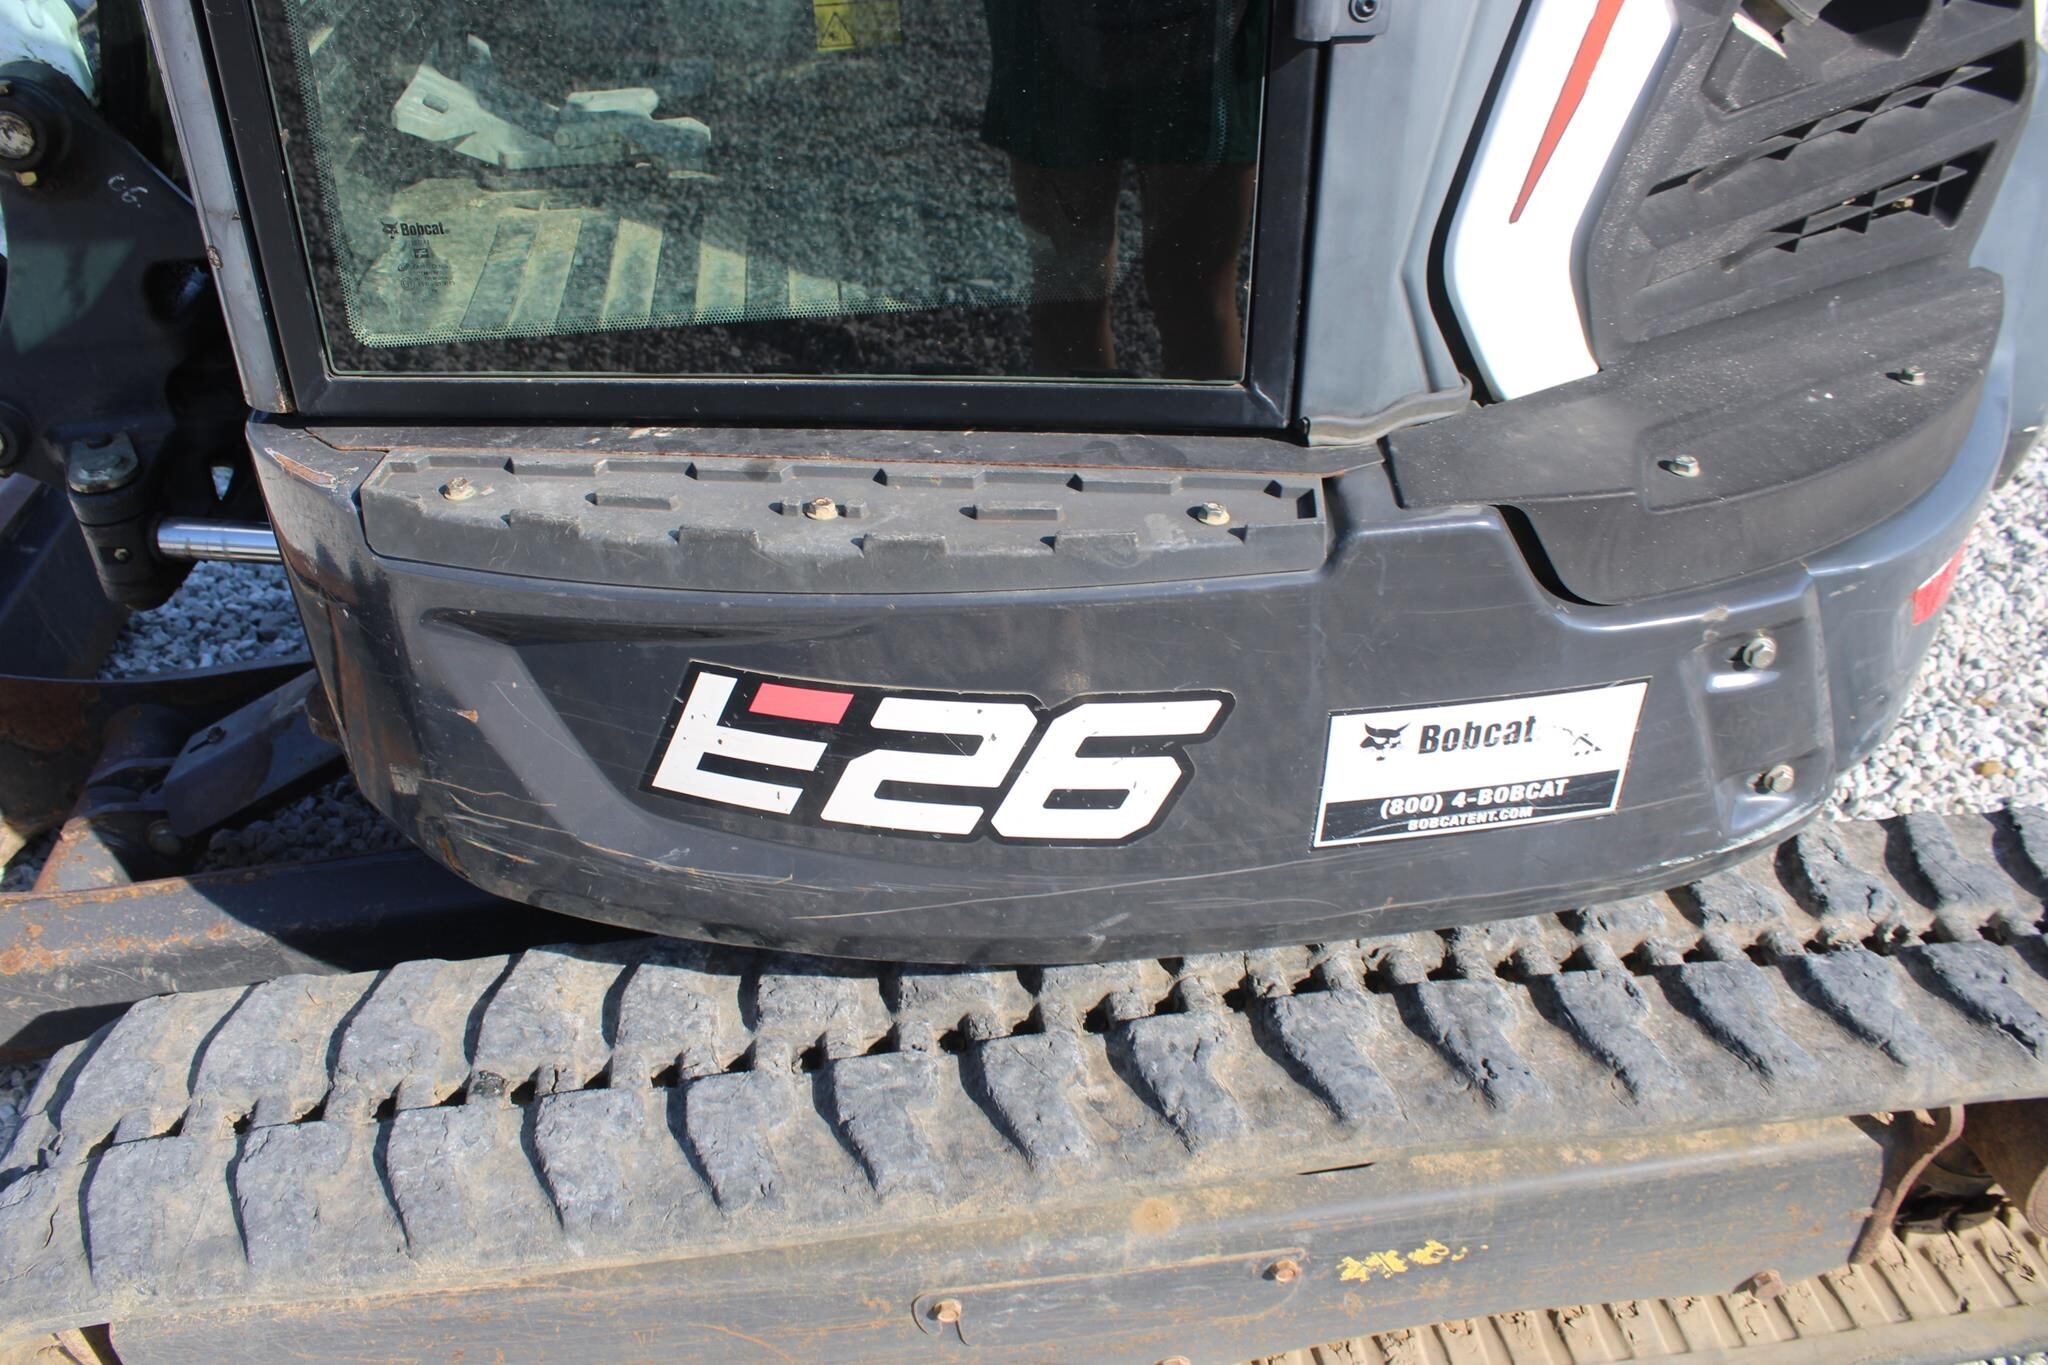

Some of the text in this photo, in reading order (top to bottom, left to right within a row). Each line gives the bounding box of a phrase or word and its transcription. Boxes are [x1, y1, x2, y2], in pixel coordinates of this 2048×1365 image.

[400, 221, 445, 236] Bobcat
[1417, 715, 1537, 755] Bobcat
[652, 671, 1222, 840] E26
[1380, 778, 1570, 820] (800) 4-BOBCAT
[1408, 806, 1533, 832] BOBCATENT.COM
